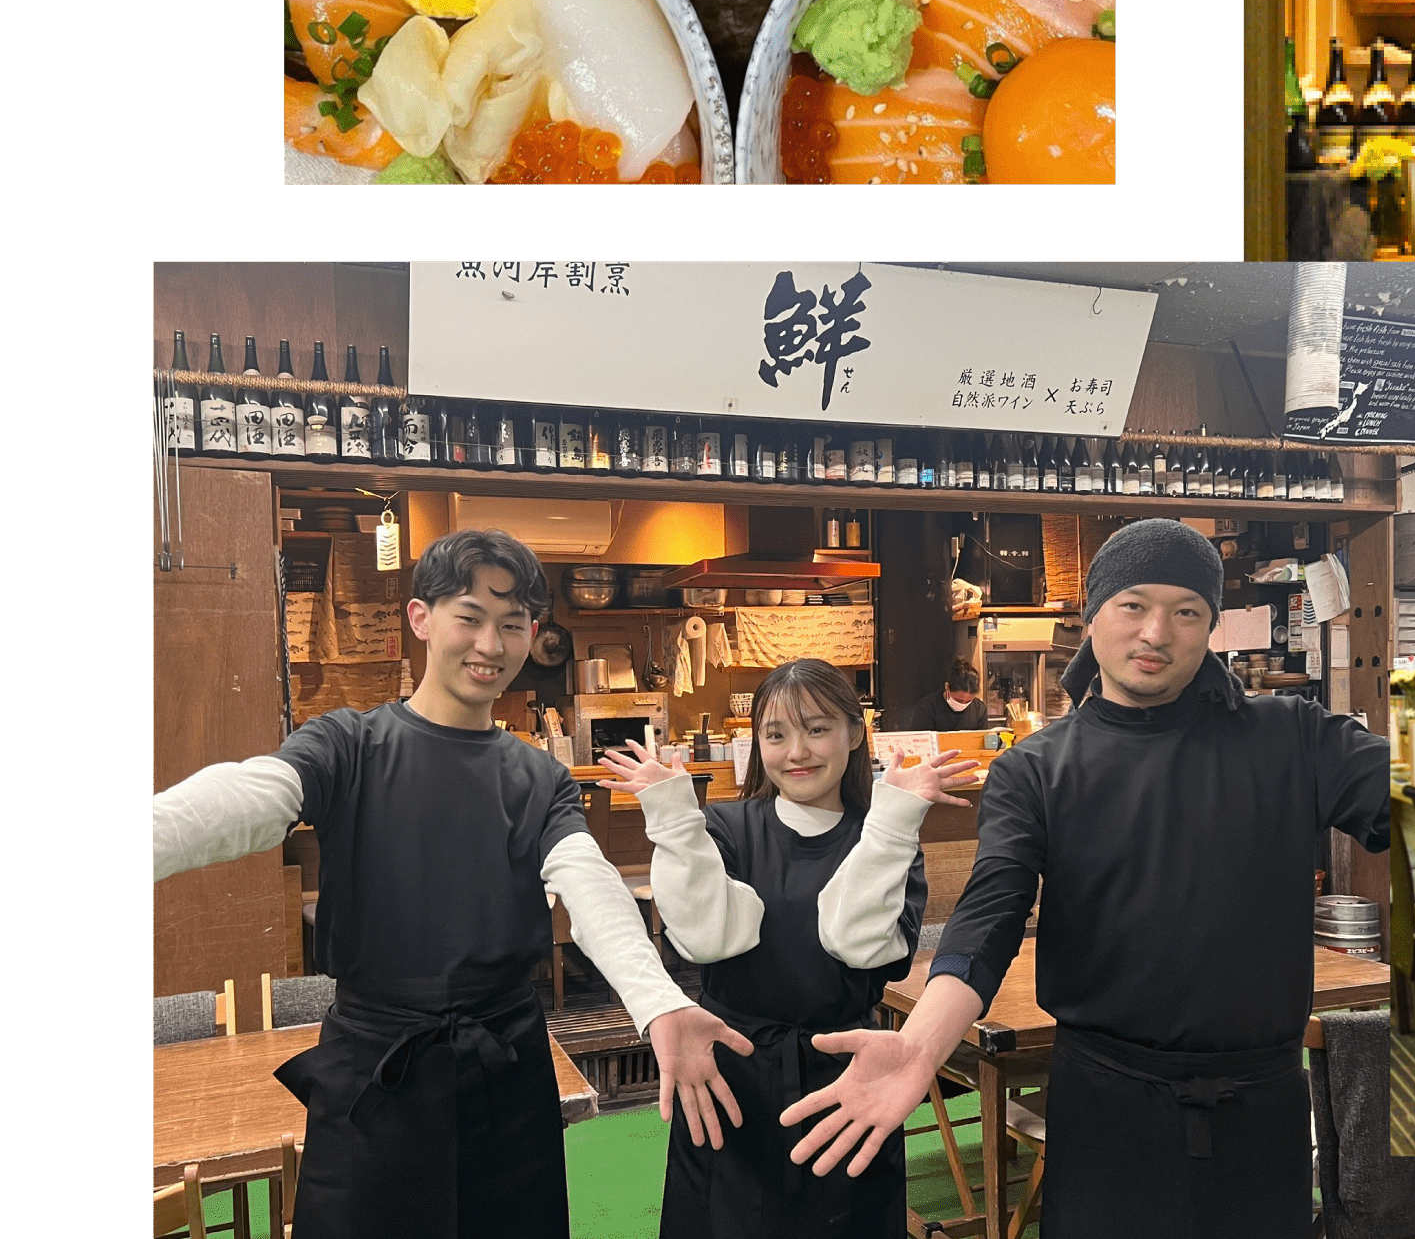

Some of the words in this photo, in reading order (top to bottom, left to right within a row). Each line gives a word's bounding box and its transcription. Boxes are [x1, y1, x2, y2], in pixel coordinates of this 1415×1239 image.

[1356, 322, 1373, 334] fresh
[1372, 324, 1388, 335] fish
[758, 270, 872, 412] 鮮
[956, 367, 1037, 390] 厳選地酒
[1345, 364, 1362, 375] Please
[840, 366, 856, 395] せん
[1069, 377, 1114, 396] お寿司
[951, 389, 1034, 410] 自然派ワイン
[1063, 399, 1106, 416] 天ぷら
[1361, 419, 1383, 428] LUNCH
[1363, 411, 1388, 420] MORNING
[244, 410, 265, 446] 田酒
[275, 412, 298, 448] 田酒
[402, 418, 419, 455] 而今
[1292, 422, 1311, 433] Japan
